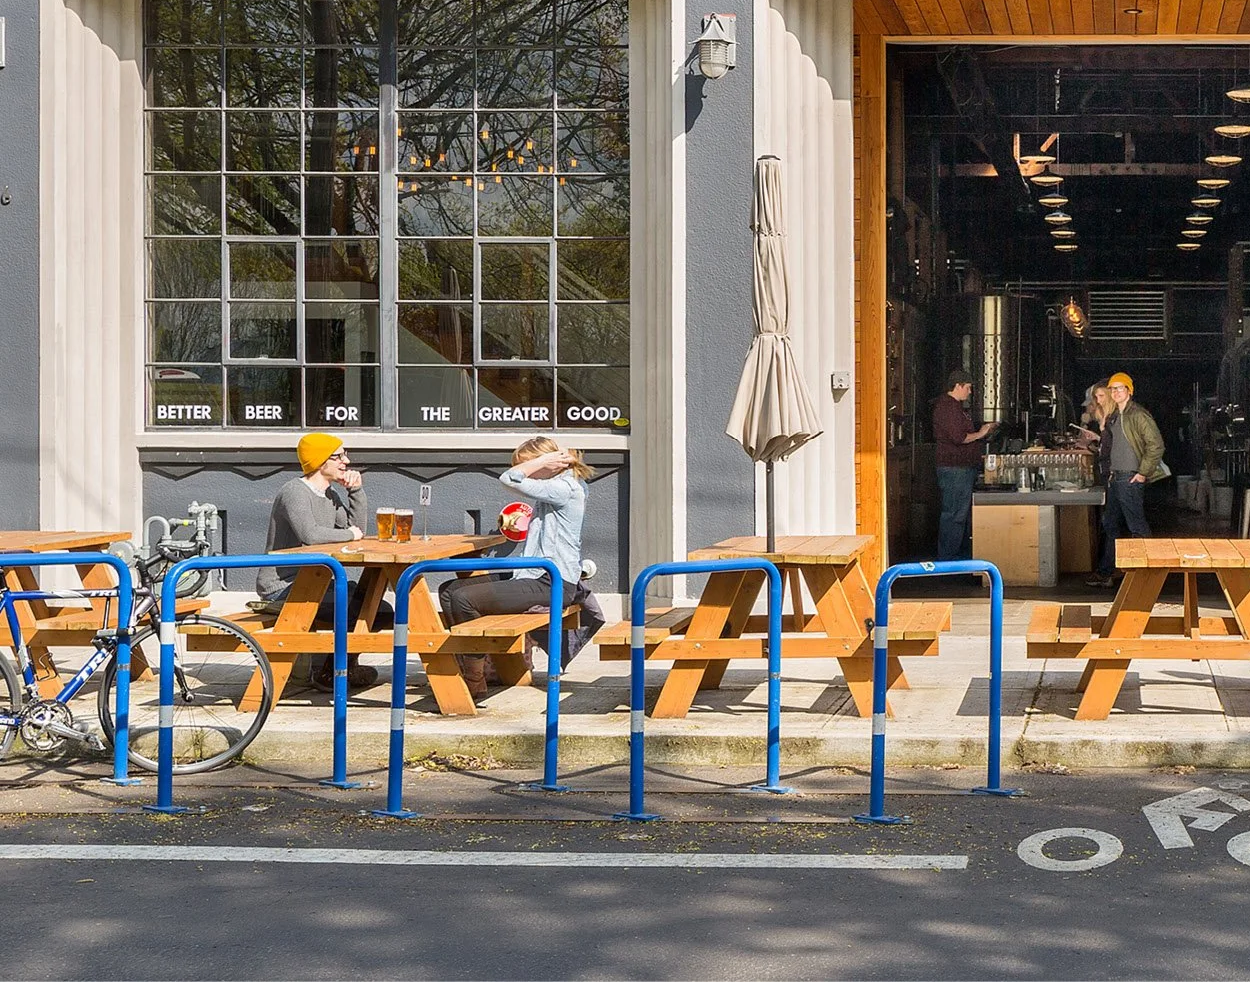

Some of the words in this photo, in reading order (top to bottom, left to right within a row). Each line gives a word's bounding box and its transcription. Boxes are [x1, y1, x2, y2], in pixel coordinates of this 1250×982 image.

[157, 405, 212, 420] BETTER
[245, 405, 282, 420] BEER
[325, 406, 359, 421] FOR
[421, 406, 450, 421] THE
[478, 406, 549, 421] GREATER
[566, 406, 621, 421] GOOD
